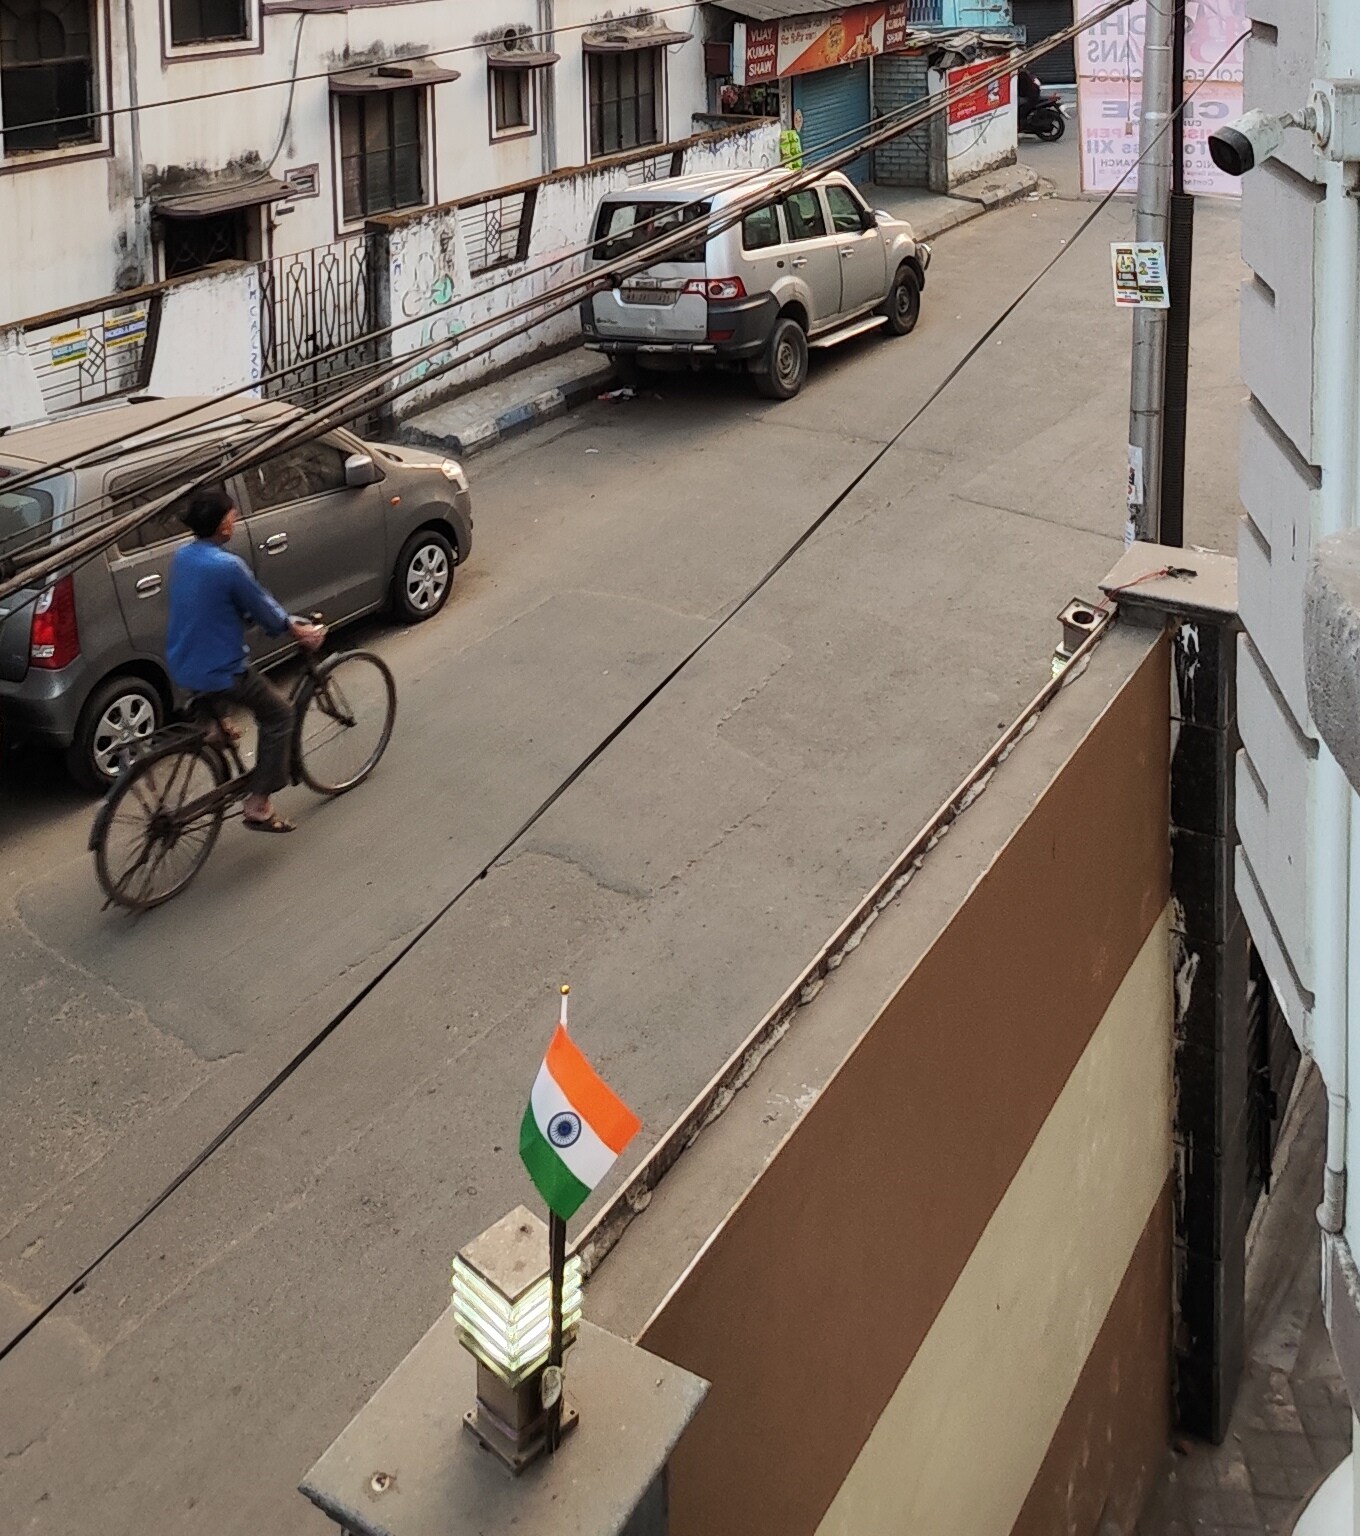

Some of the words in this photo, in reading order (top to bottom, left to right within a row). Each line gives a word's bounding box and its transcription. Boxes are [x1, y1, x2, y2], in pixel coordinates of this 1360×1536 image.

[885, 15, 907, 31] KUMAR
[751, 27, 774, 43] VIJAY
[886, 31, 904, 46] SHAW
[746, 44, 776, 60] KUMAR
[748, 60, 774, 77] SHAW
